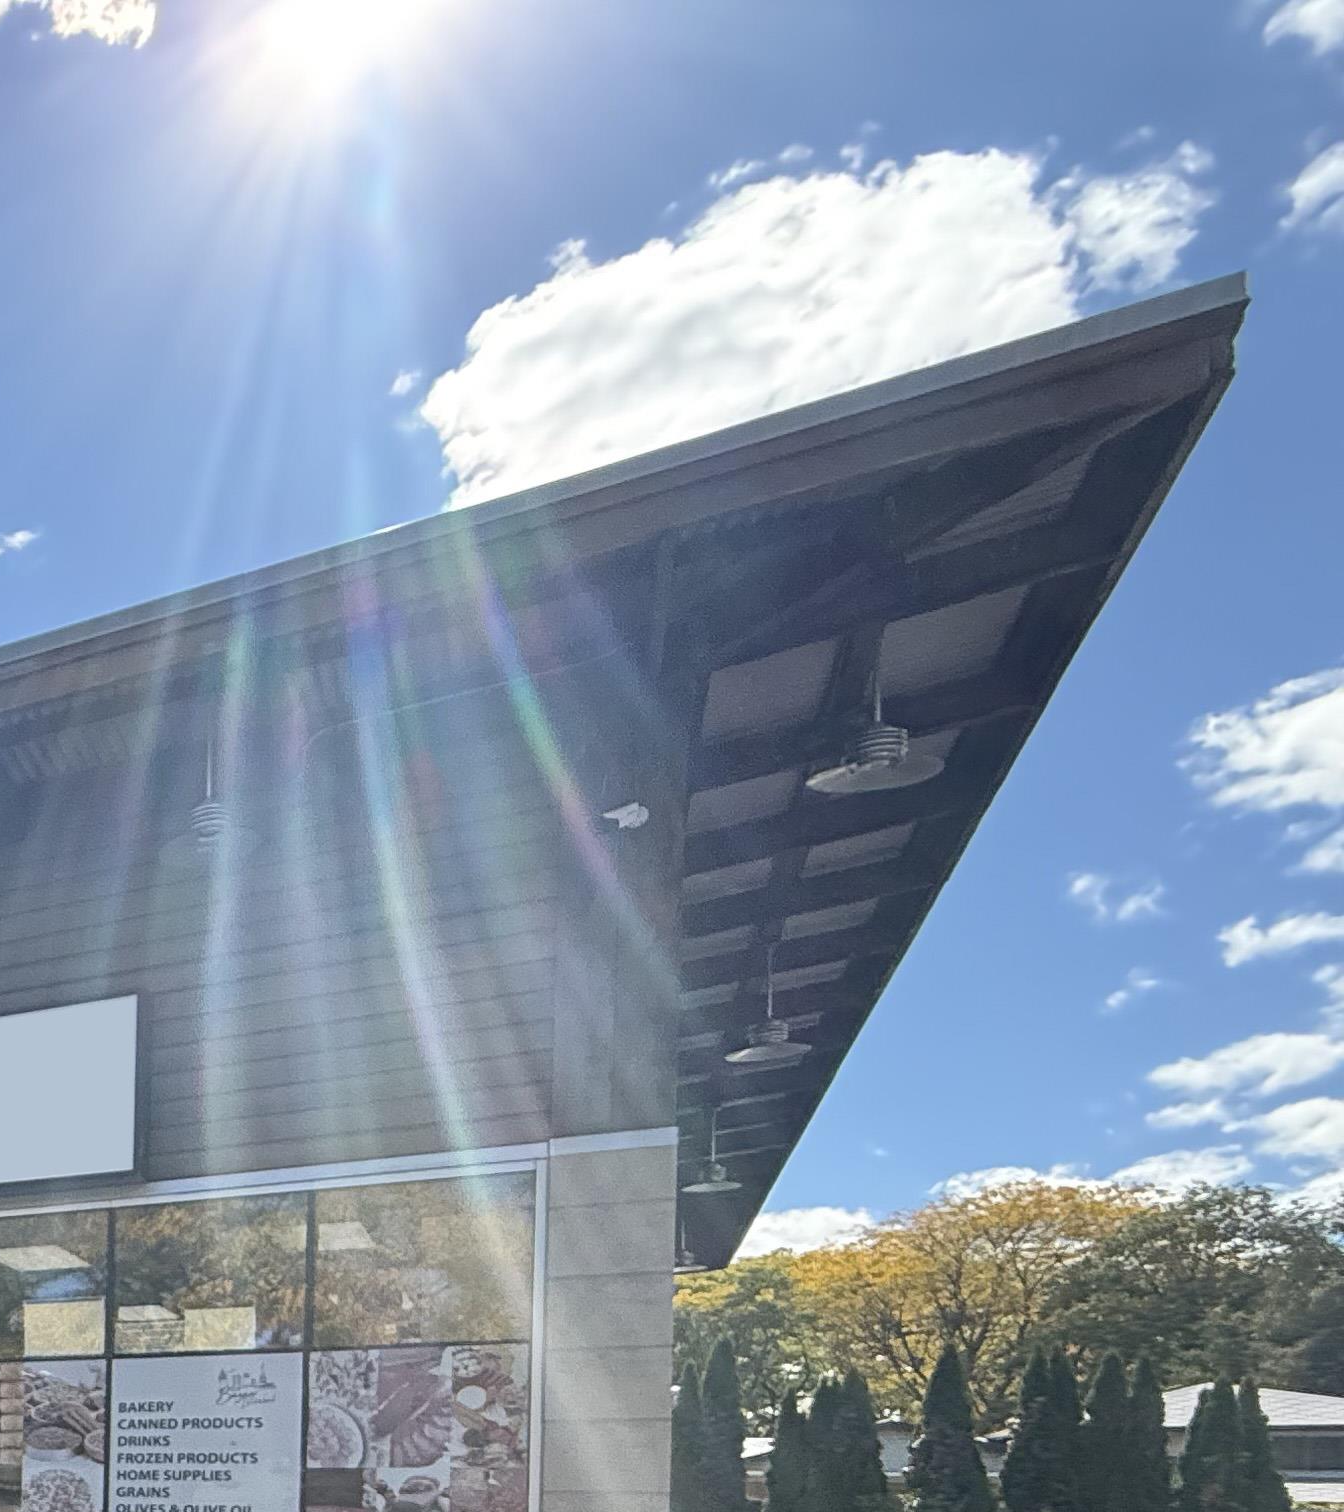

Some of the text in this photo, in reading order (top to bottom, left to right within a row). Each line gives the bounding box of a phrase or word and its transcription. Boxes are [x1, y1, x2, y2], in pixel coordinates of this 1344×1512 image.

[118, 1401, 174, 1413] BAKERY
[117, 1417, 264, 1430] CANNED PRODUCTS
[117, 1436, 171, 1447] DRINKS
[117, 1452, 259, 1464] FROZEN PRODUCTS
[117, 1470, 232, 1481] HOME SUPPLIES
[116, 1487, 170, 1498] GRAINS
